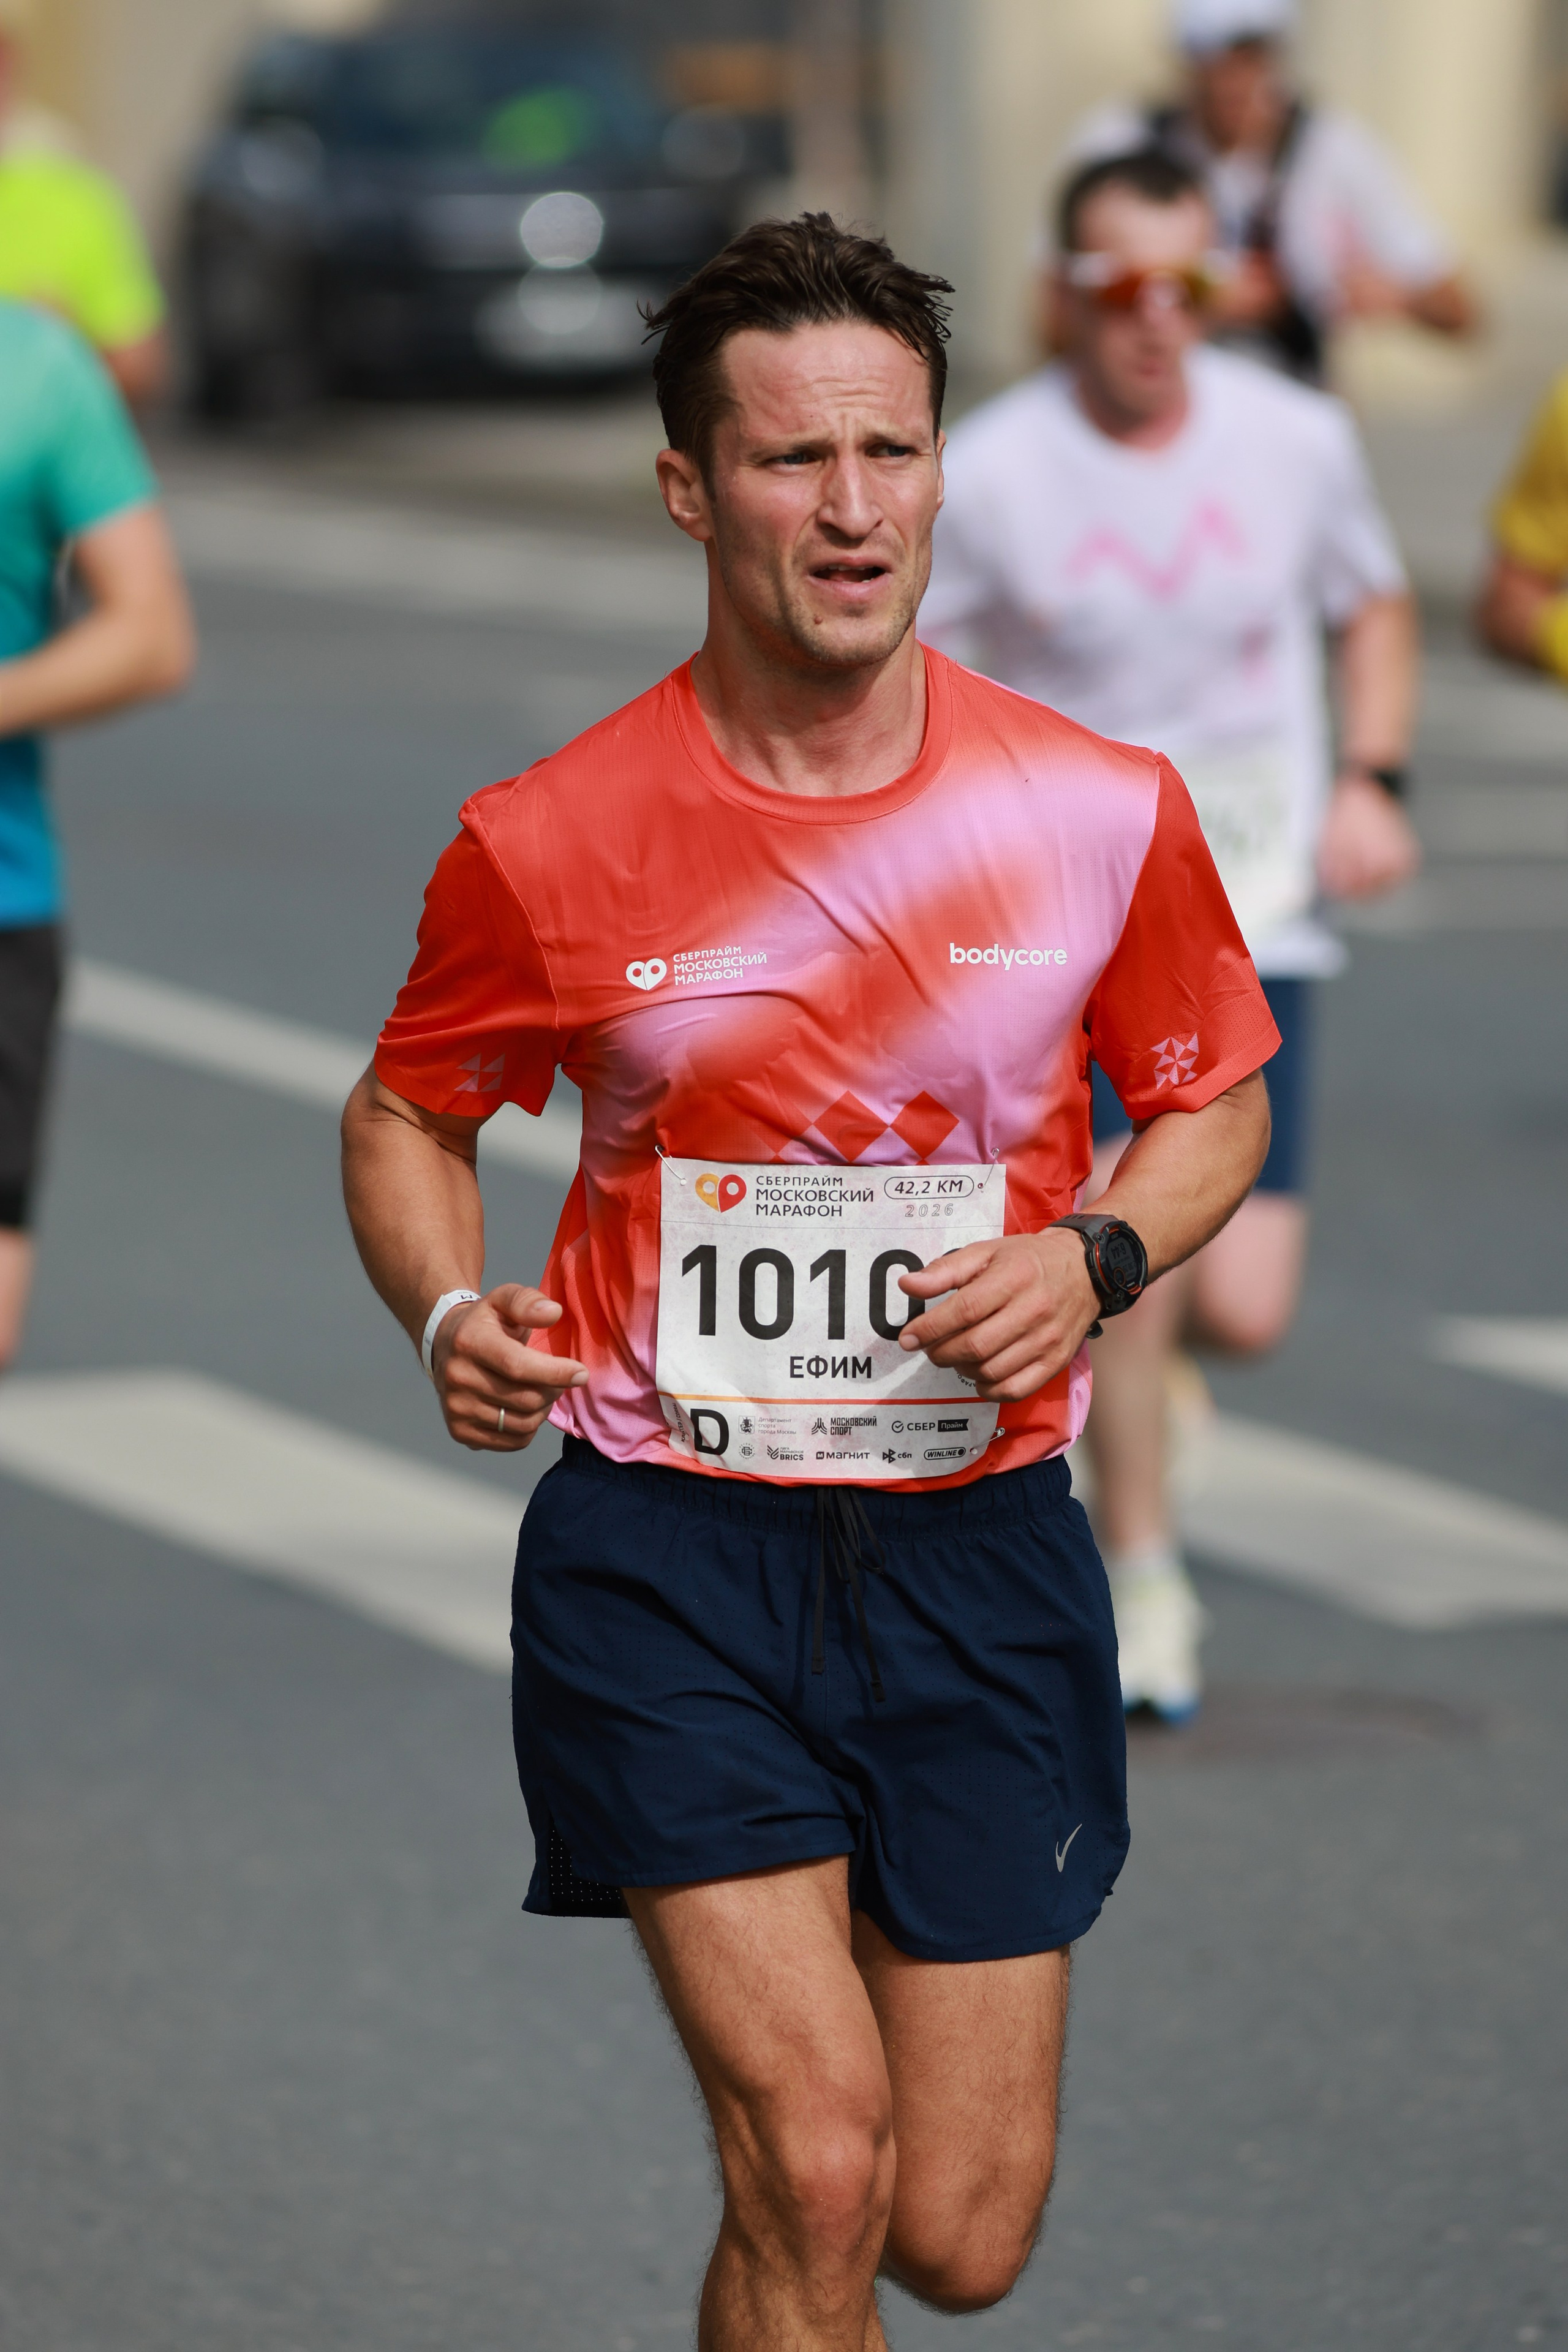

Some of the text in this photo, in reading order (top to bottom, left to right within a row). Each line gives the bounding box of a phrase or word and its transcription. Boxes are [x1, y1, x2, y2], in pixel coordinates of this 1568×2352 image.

[673, 945, 742, 962] СБЕРПРАЙМ
[949, 942, 1068, 971] bodycore
[674, 951, 767, 974] МОСКОВСКИЙ
[674, 967, 744, 986] МАРАФОН
[756, 1174, 843, 1186] СБЕРПРАЙМ
[756, 1187, 874, 1202] МОСКОВСКИЙ
[894, 1180, 963, 1196] 42,2 КМ
[756, 1204, 843, 1217] МАРАФОН
[905, 1204, 954, 1218] 2026
[682, 1244, 962, 1341] 1010
[790, 1355, 872, 1379] ЕФИМ
[830, 1415, 877, 1427] МОСКОВСКИЙ
[907, 1422, 936, 1431] СБЕР
[690, 1408, 729, 1455] D
[830, 1427, 852, 1435] СПОРТ
[927, 1449, 957, 1458] WINLINE
